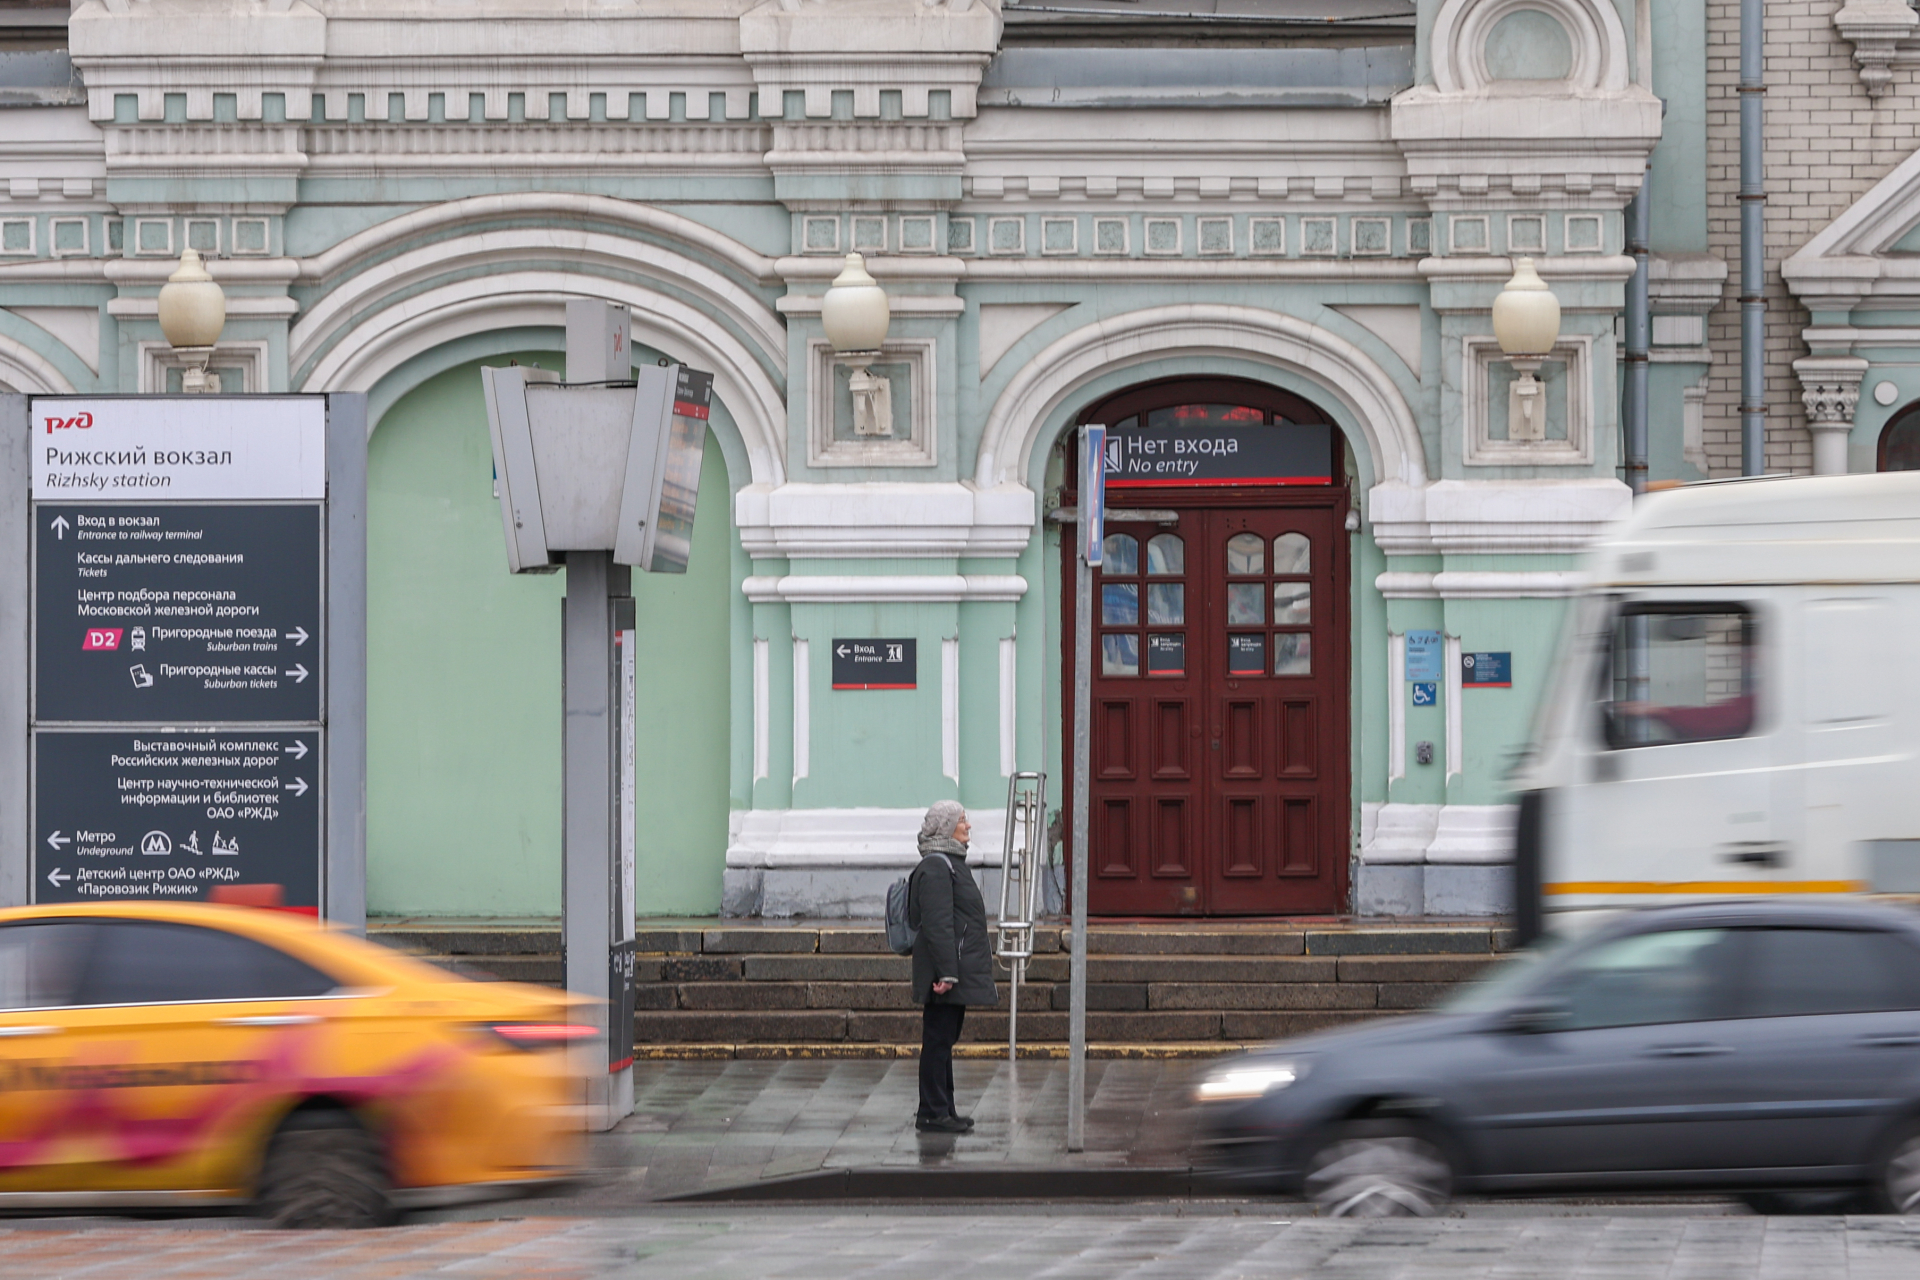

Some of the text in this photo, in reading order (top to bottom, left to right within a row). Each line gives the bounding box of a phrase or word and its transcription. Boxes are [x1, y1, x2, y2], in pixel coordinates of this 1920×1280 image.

[1128, 436, 1238, 456] Нет входа
[46, 445, 232, 465] Рижский вокзал
[1128, 458, 1199, 475] No entry
[46, 472, 171, 491] Rizhsky station
[77, 514, 160, 528] Вход в вокзал
[77, 530, 203, 542] Entrance to railway terminal
[77, 552, 244, 566] Кассы дальнего следования
[77, 567, 108, 578] Tickets
[77, 588, 236, 603] Центр подбора персонала
[77, 604, 260, 618] Московской железной дороги
[152, 627, 277, 640] Пригородные поезда
[206, 641, 278, 652] Suburban trains
[854, 644, 875, 654] Вход
[854, 655, 883, 663] Entrance
[160, 664, 277, 677] Пригородные кассы
[203, 678, 278, 689] Suburban tickets
[133, 739, 279, 752] Выставочный комплекс
[111, 754, 279, 769] Российских железных дорог
[117, 776, 279, 791] Центр научно-технической
[121, 792, 279, 806] информации и библиотек
[206, 807, 279, 820] ОАО «РЖД»
[76, 831, 116, 844] Метро
[76, 845, 134, 857] Undeground
[76, 867, 240, 882] Детский центр ОАО «РЖД»
[77, 882, 199, 895] «Паровозик Рижик»
